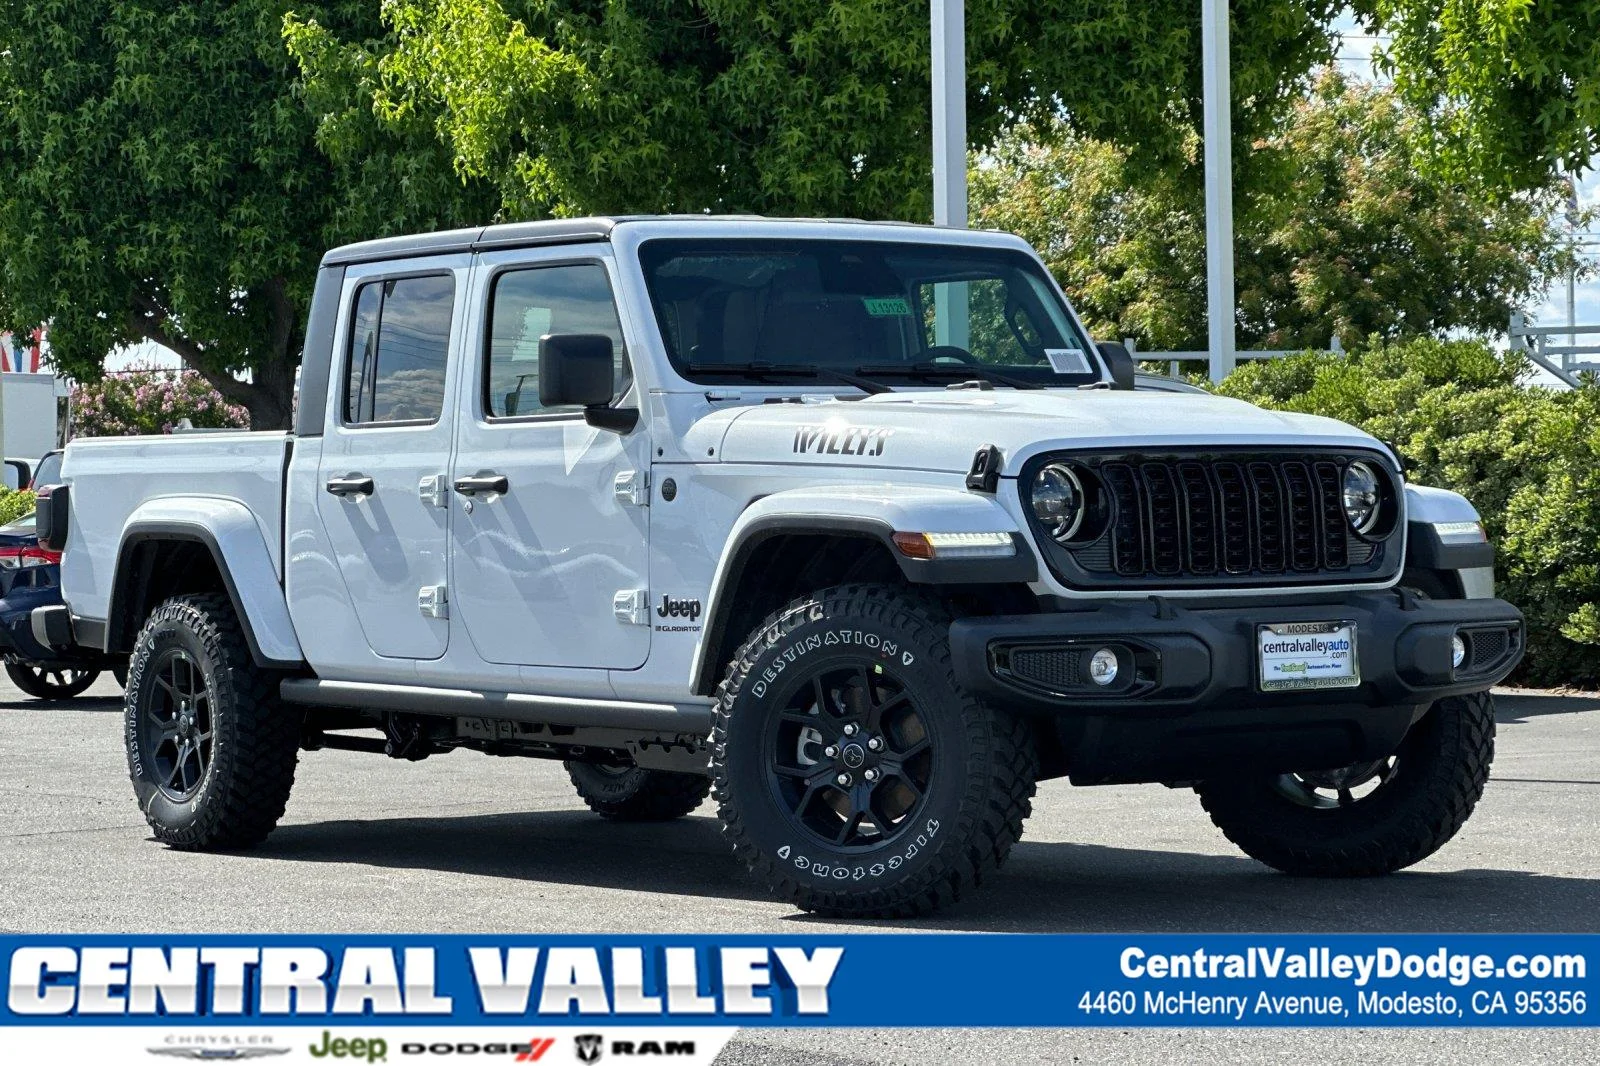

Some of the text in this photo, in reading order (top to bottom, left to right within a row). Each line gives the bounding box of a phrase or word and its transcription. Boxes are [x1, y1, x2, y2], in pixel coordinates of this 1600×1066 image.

[656, 593, 701, 622] Jeep
[752, 630, 898, 698] DESTINATION
[1263, 638, 1349, 655] centralvalleyauto
[128, 649, 150, 777] DESTINATION
